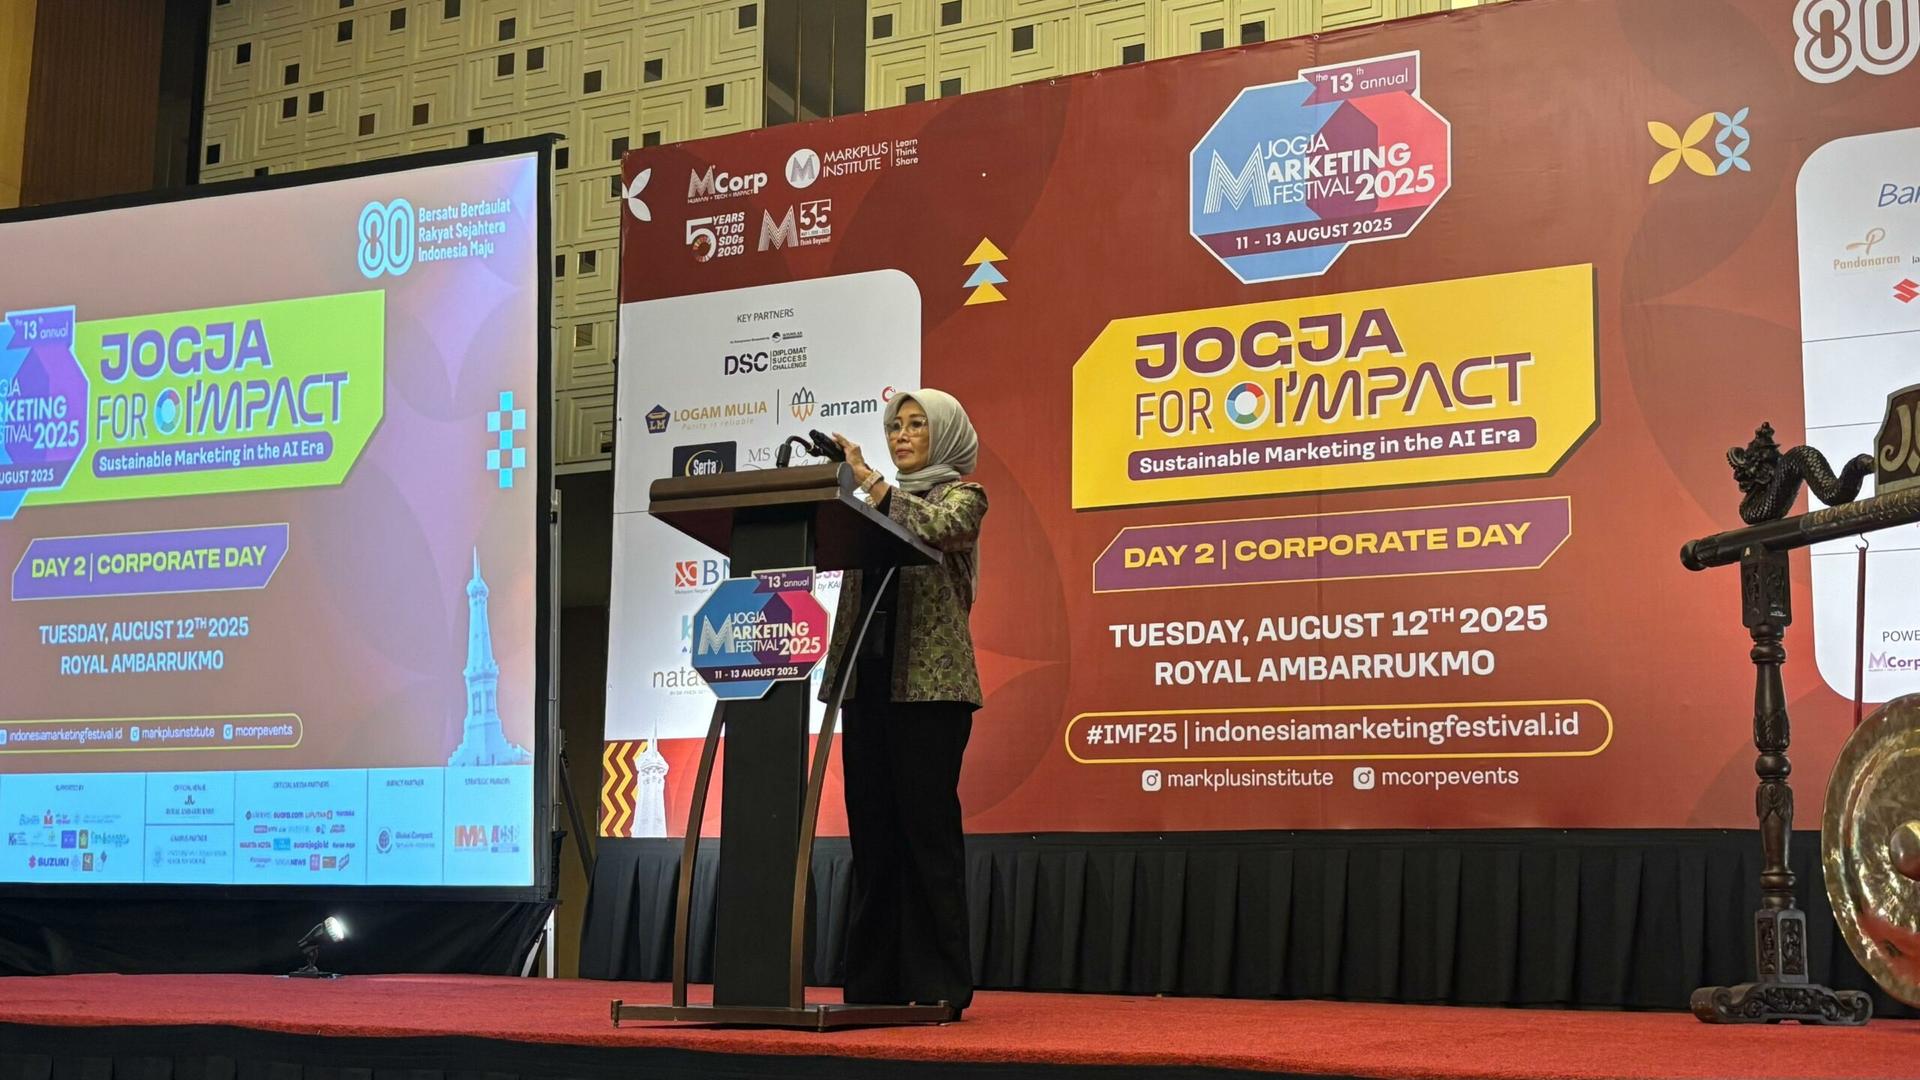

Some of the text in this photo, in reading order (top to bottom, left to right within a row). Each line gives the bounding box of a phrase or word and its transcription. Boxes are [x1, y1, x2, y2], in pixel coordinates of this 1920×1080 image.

[1315, 73, 1328, 82] the
[1360, 68, 1409, 90] annual
[824, 142, 888, 163] MARKPLUS
[895, 138, 918, 148] Learn
[895, 147, 918, 157] Think
[1264, 132, 1330, 160] JOGJA
[823, 158, 881, 178] INSTITUTE
[895, 157, 919, 167] Share
[687, 165, 768, 198] MCorp
[1203, 142, 1412, 214] MARKETING
[1273, 165, 1435, 205] FESTIVAL 2025
[418, 198, 511, 223] Bersatu Berdaulat
[712, 211, 745, 226] YEARS
[800, 199, 831, 231] 35
[357, 198, 415, 279] 80
[418, 220, 506, 243] Rakyat Sejahtera
[685, 217, 717, 263] 5
[715, 222, 745, 236] TO GO
[718, 234, 745, 246] SDGs
[1235, 236, 1249, 250] 11
[1265, 232, 1282, 246] 13
[1285, 223, 1349, 244] AUGUST
[1352, 218, 1393, 235] 2025
[418, 239, 495, 262] Indonesia Maju
[717, 245, 745, 258] 2030
[1833, 255, 1901, 271] Pandanaran
[737, 308, 794, 323] KEY PARTNERS
[40, 321, 69, 339] annual
[100, 319, 273, 383] JOGJA
[772, 346, 807, 357] DIPLOMAT
[1135, 308, 1406, 382] JOGJA
[724, 351, 769, 375] DSC
[772, 354, 807, 364] SUCCESS
[772, 361, 807, 371] CHALLENGE
[96, 393, 148, 442] FOR
[673, 401, 768, 422] LOGAM MULIA
[1136, 387, 1214, 440] FOR
[33, 420, 79, 449] 2025
[648, 419, 666, 431] LM
[99, 439, 324, 472] Sustainable Marketing in the AI Era
[748, 447, 771, 462] MS
[1139, 427, 1521, 474] Sustainable Marketing in the AI Era
[31, 468, 54, 483] 2025
[693, 459, 717, 476] Serta
[1124, 522, 1532, 569] DAY 2 CORPORATE DAY
[31, 545, 267, 578] DAY 2 CORPORATE DAY
[783, 576, 810, 588] annual
[731, 611, 767, 625] JOGJA
[1109, 618, 1249, 648] TUESDAY,
[1256, 612, 1385, 642] AUGUST
[1459, 604, 1548, 634] 2025
[39, 623, 109, 645] TUESDAY,
[111, 620, 174, 642] AUGUST
[208, 616, 249, 637] 2025
[698, 612, 810, 656] MARKETING
[735, 637, 821, 656] FESTIVAL 2025
[60, 649, 224, 675] ROYAL AMBARRUKMO
[714, 670, 722, 679] 11
[730, 669, 740, 678] 13
[741, 667, 776, 678] AUGUST
[777, 666, 799, 676] 2025
[1155, 649, 1495, 686] ROYAL AMBARRUKMO
[1086, 711, 1579, 746] #IMF25 indonesiamarketingfestival.id
[1167, 766, 1520, 792] markplusinstitute mcorpevents
